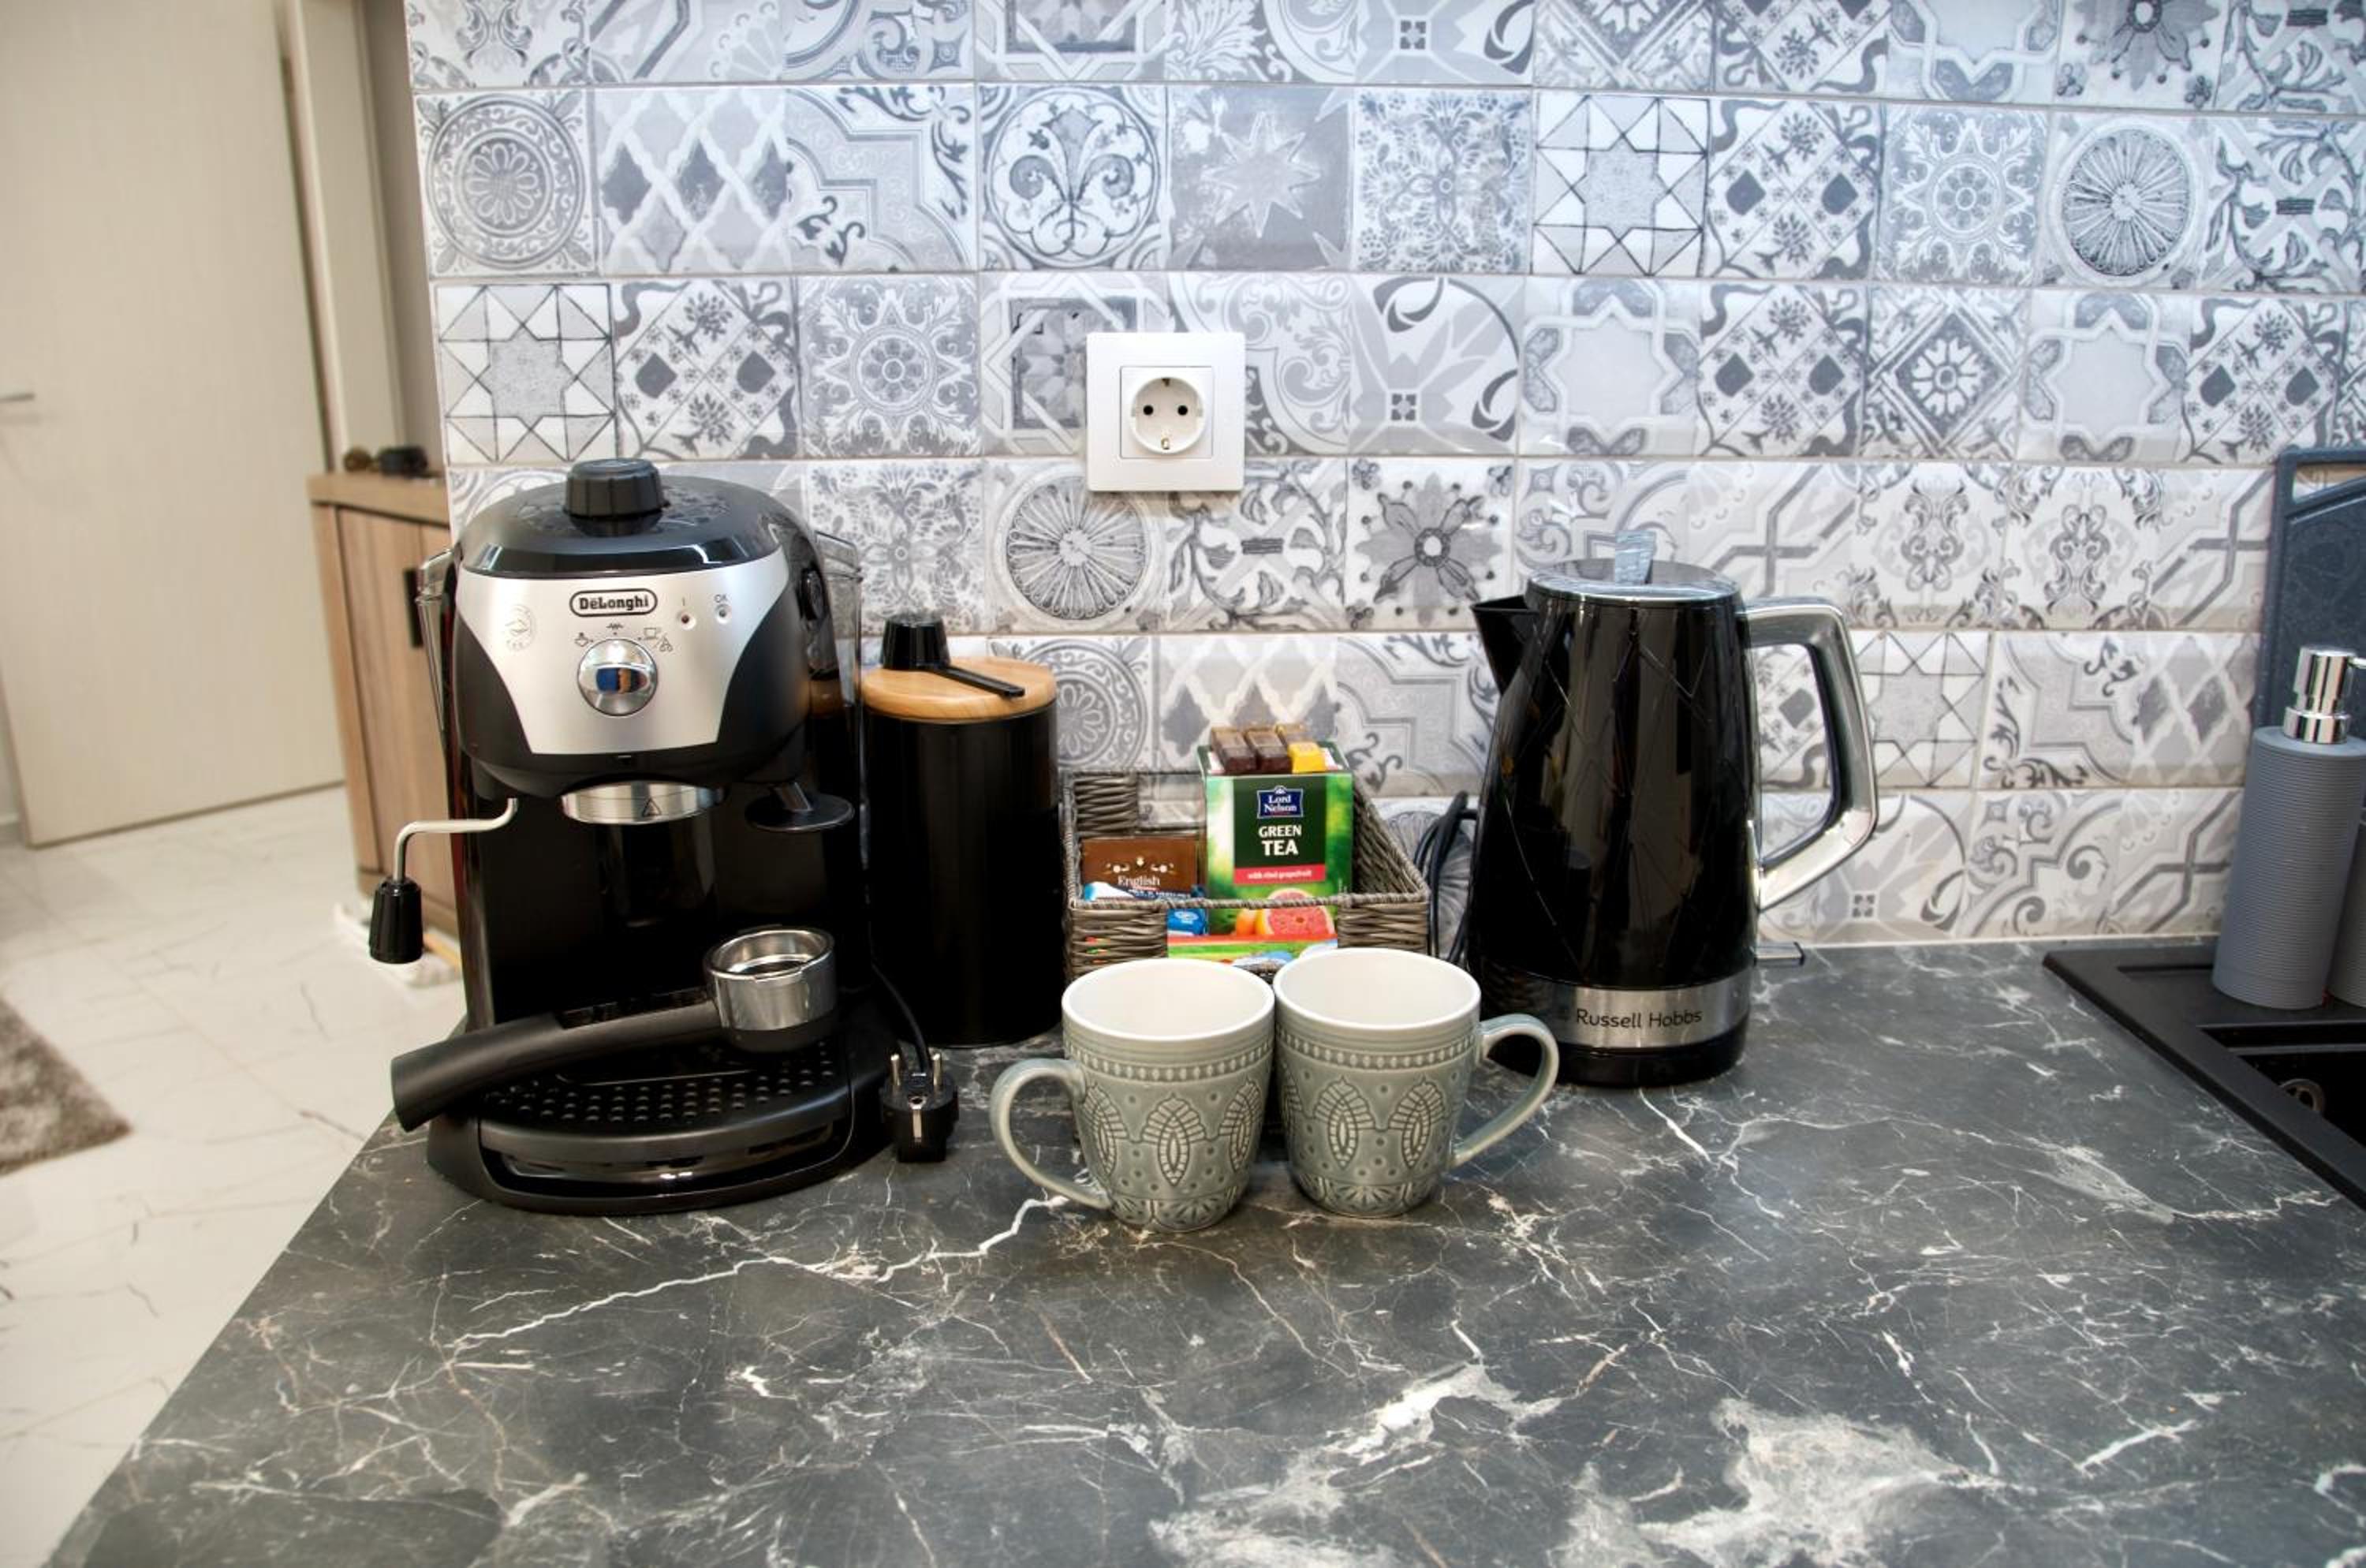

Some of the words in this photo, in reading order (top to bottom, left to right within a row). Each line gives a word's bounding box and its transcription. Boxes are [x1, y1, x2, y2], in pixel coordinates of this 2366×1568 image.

[1268, 794, 1291, 804] Lord
[1263, 803, 1297, 813] Nelson
[1258, 825, 1302, 838] GREEN
[1261, 839, 1299, 857] TEA
[1577, 1008, 1641, 1029] Russell
[1648, 1009, 1703, 1028] Hobbs
